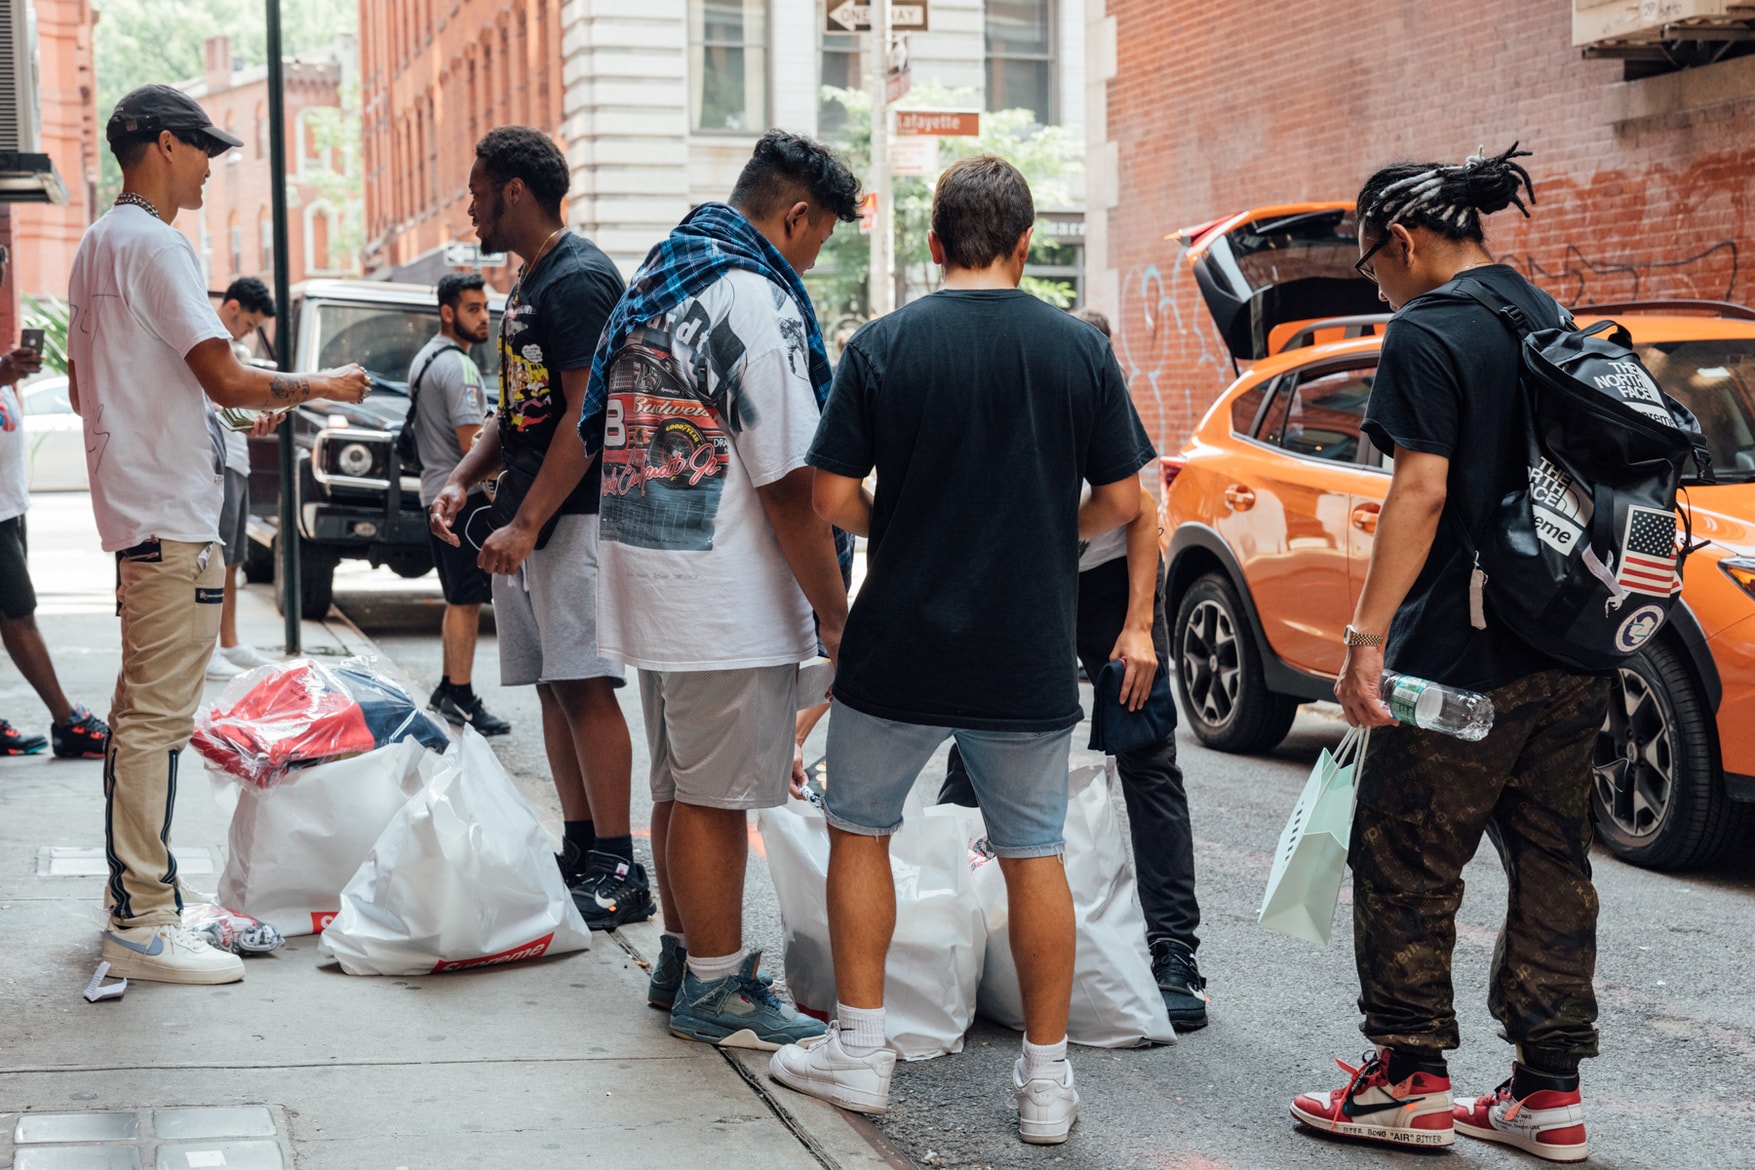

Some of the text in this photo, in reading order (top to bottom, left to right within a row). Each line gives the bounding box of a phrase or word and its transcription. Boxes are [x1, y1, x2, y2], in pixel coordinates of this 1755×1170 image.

[896, 114, 961, 132] Lafayette
[1607, 361, 1639, 375] THE
[1593, 373, 1649, 389] NORTH
[1617, 385, 1653, 401] FACE
[1539, 455, 1573, 487] THE
[1527, 465, 1566, 497] RTH
[1529, 482, 1562, 508] CE
[1390, 1132, 1414, 1142] "AIR"
